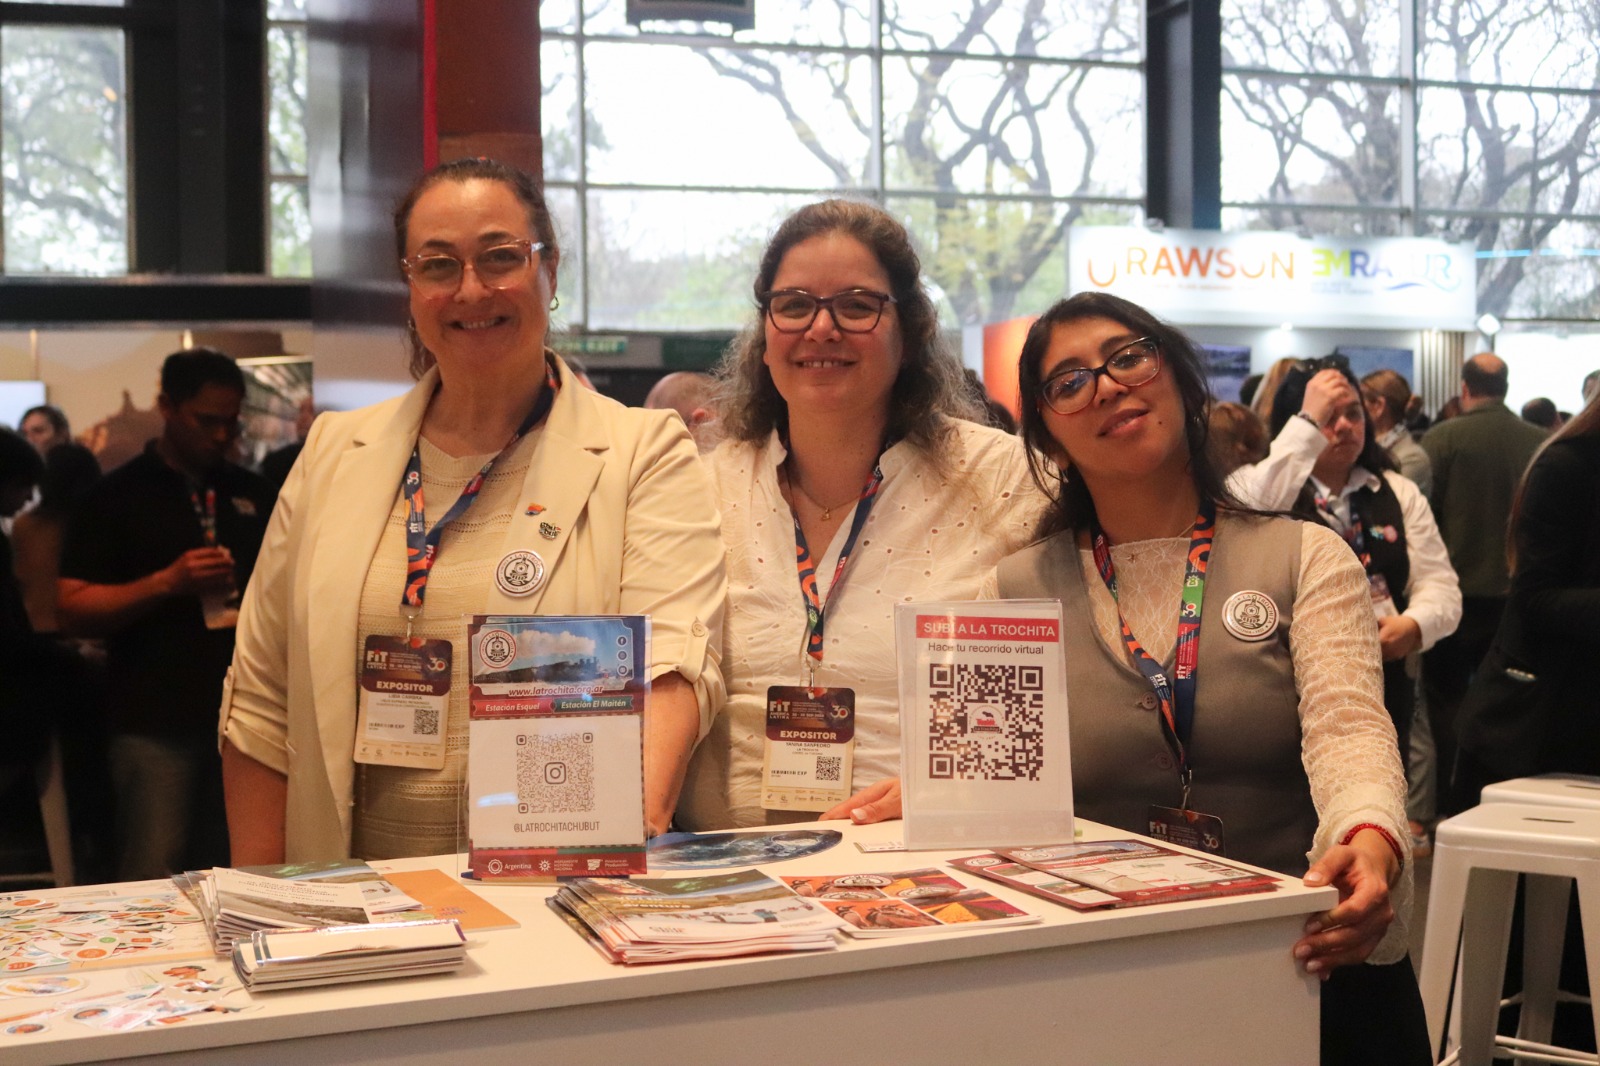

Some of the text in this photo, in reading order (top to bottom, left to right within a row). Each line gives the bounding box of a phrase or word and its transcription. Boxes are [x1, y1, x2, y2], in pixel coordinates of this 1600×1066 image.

[1127, 246, 1294, 279] RAWSON
[958, 624, 967, 634] A
[970, 624, 987, 635] LA
[990, 624, 1056, 637] TROCHITA
[956, 644, 966, 652] tu
[968, 644, 1012, 654] recorrido
[1015, 645, 1044, 655] virtual
[376, 681, 434, 693] EXPOSITOR
[508, 685, 604, 697] www.latrochita.org.ar
[485, 703, 540, 712] Estación Esquel
[561, 701, 591, 709] Estación
[600, 700, 626, 708] Maitén
[780, 730, 837, 740] EXPOSITOR
[513, 821, 600, 833] @LATROCHITACHUBUT
